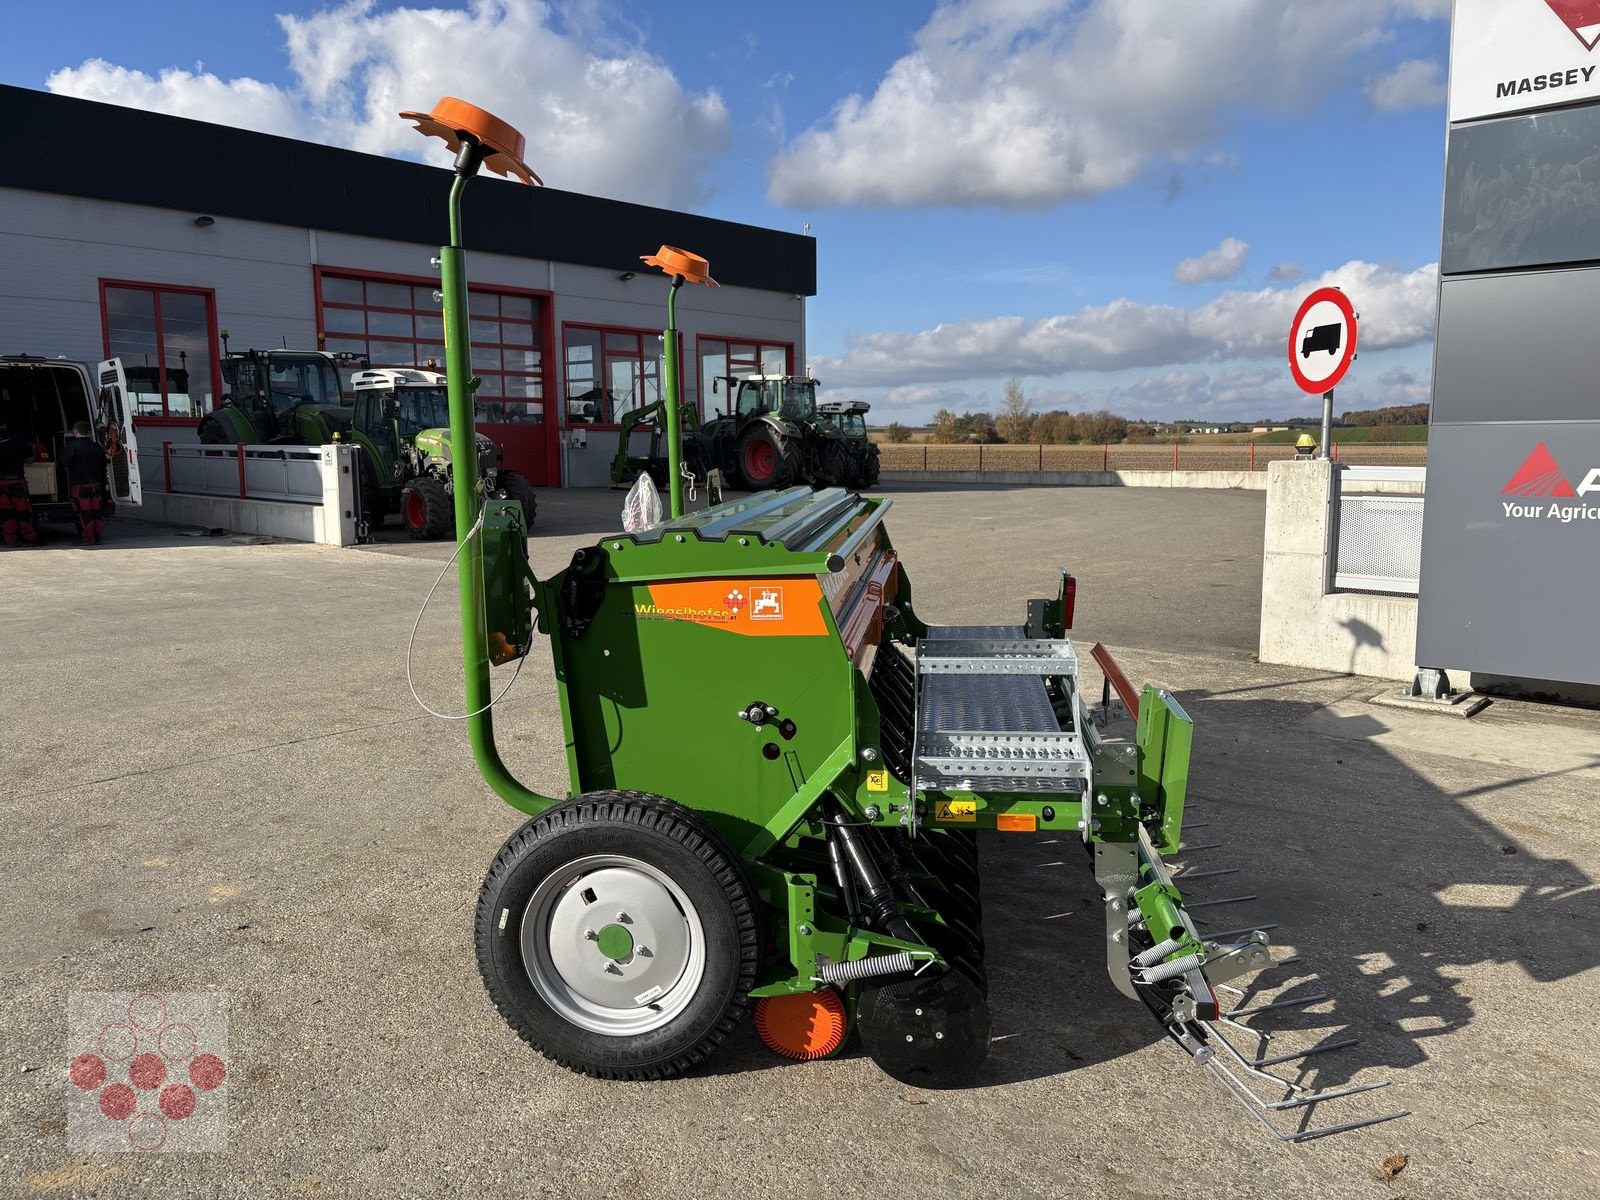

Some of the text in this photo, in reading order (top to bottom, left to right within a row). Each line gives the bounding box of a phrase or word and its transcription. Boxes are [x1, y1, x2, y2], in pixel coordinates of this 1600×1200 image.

[1496, 65, 1596, 98] MASSEY
[1502, 502, 1600, 523] Your Agric
